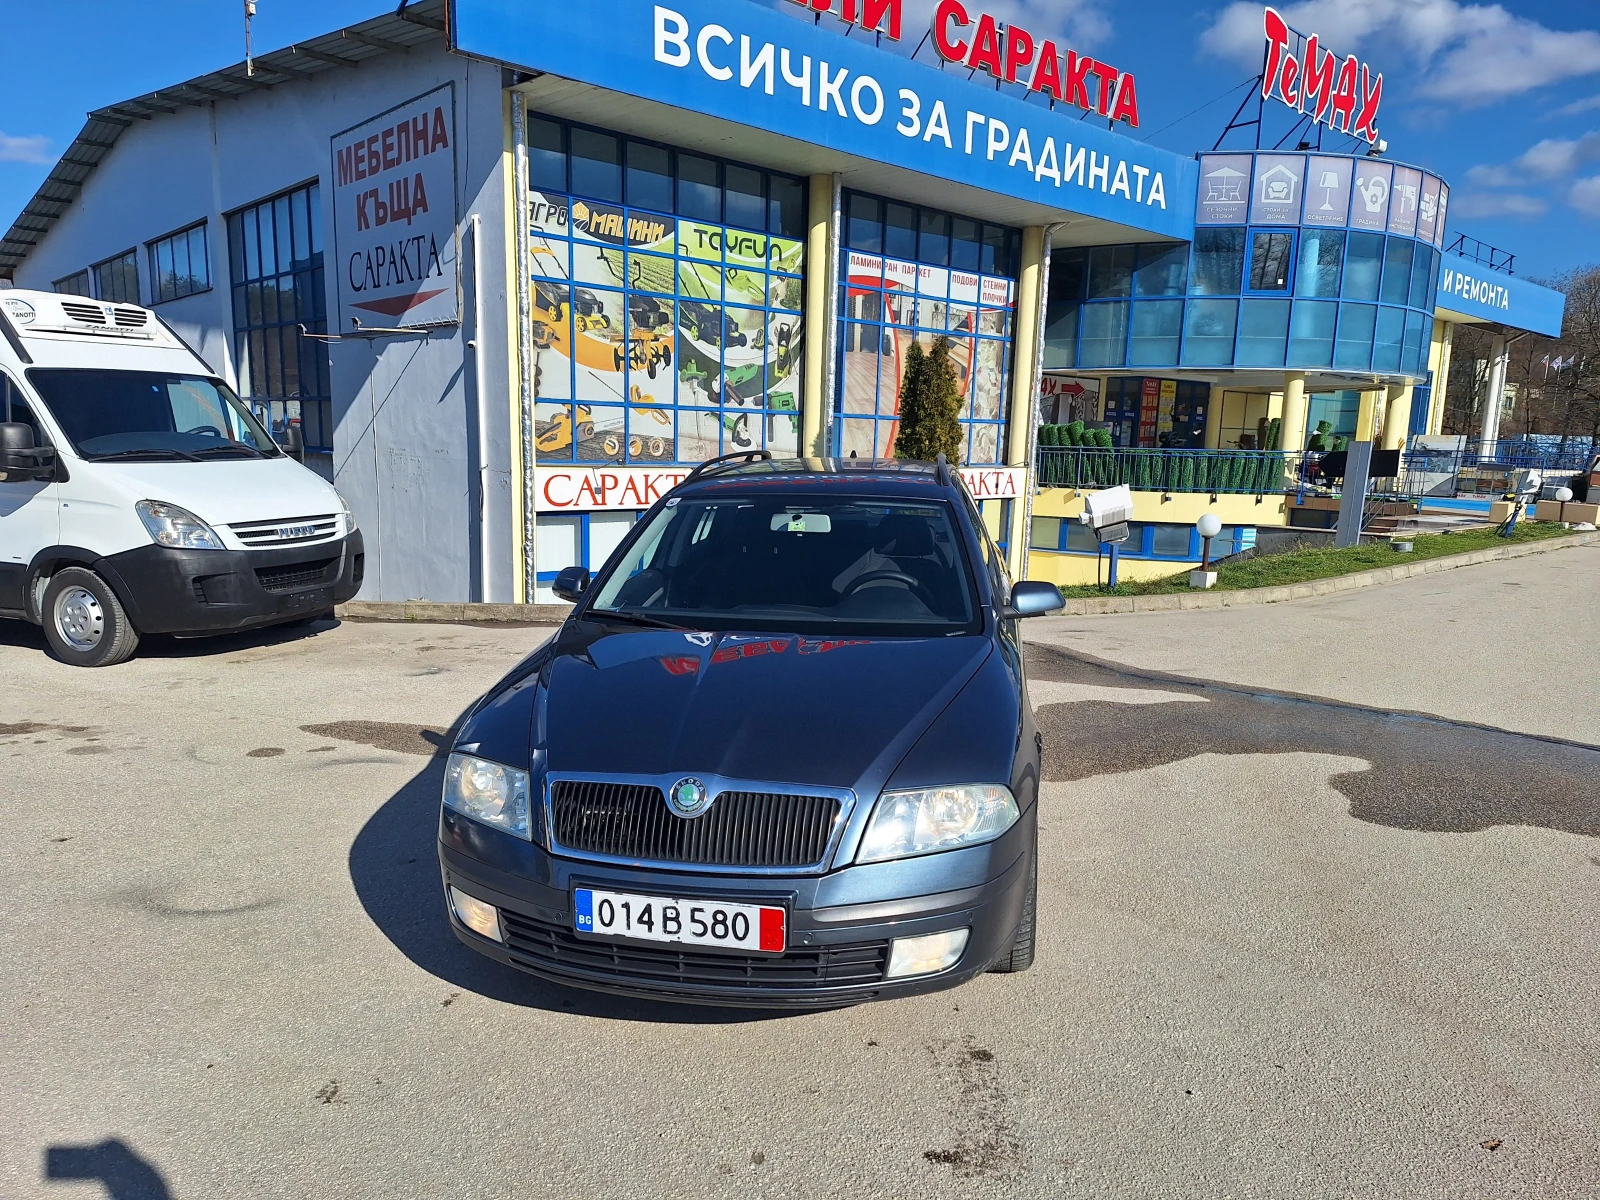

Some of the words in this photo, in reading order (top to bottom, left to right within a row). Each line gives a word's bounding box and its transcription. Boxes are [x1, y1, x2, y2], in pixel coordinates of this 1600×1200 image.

[931, 0, 1140, 128] САРАКТА
[654, 4, 885, 126] ВСИЧКО
[896, 88, 952, 149] ЗА
[964, 110, 1167, 210] ГРАДИНАТА
[337, 106, 449, 188] МЕБЕЛНА
[356, 172, 429, 232] КЪЩА
[1307, 214, 1344, 222] ОСВЕТЛЕНИЕ
[590, 210, 665, 244] МАШИНИ
[1356, 218, 1380, 226] ГРАДИНА
[349, 232, 443, 292] САРАКТА
[850, 255, 898, 273] ЛАМИНИРАН
[902, 264, 932, 279] ПАРКЕТ
[952, 274, 978, 287] ПОДОВИ
[983, 279, 1007, 290] СТЕННИ
[982, 292, 1008, 304] ПЛОЧКИ
[1443, 268, 1454, 293] И
[1454, 272, 1509, 311] РЕМОНТА
[543, 474, 686, 507] САРАКТ
[579, 915, 592, 925] BG
